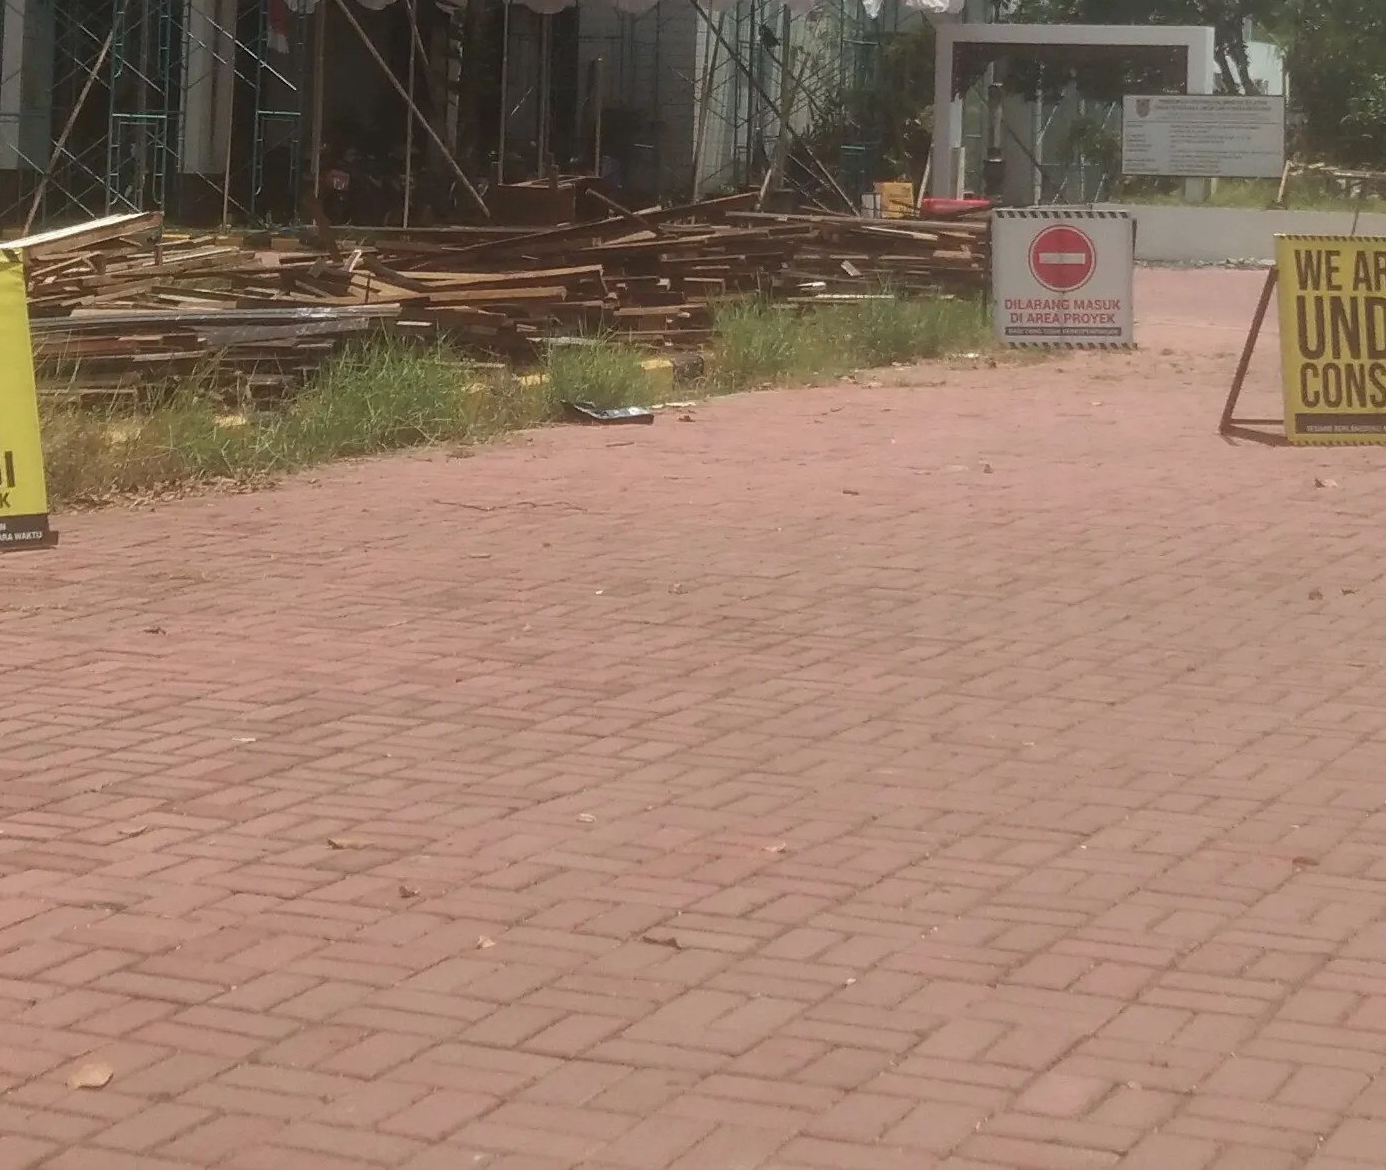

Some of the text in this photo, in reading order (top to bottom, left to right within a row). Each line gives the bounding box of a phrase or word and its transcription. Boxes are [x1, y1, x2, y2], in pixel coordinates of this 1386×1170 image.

[1294, 250, 1342, 291] WE
[1004, 299, 1121, 310] DILARANG MASUK
[1010, 313, 1115, 323] DI AREA PROYEK
[14, 531, 43, 541] WAKTU
